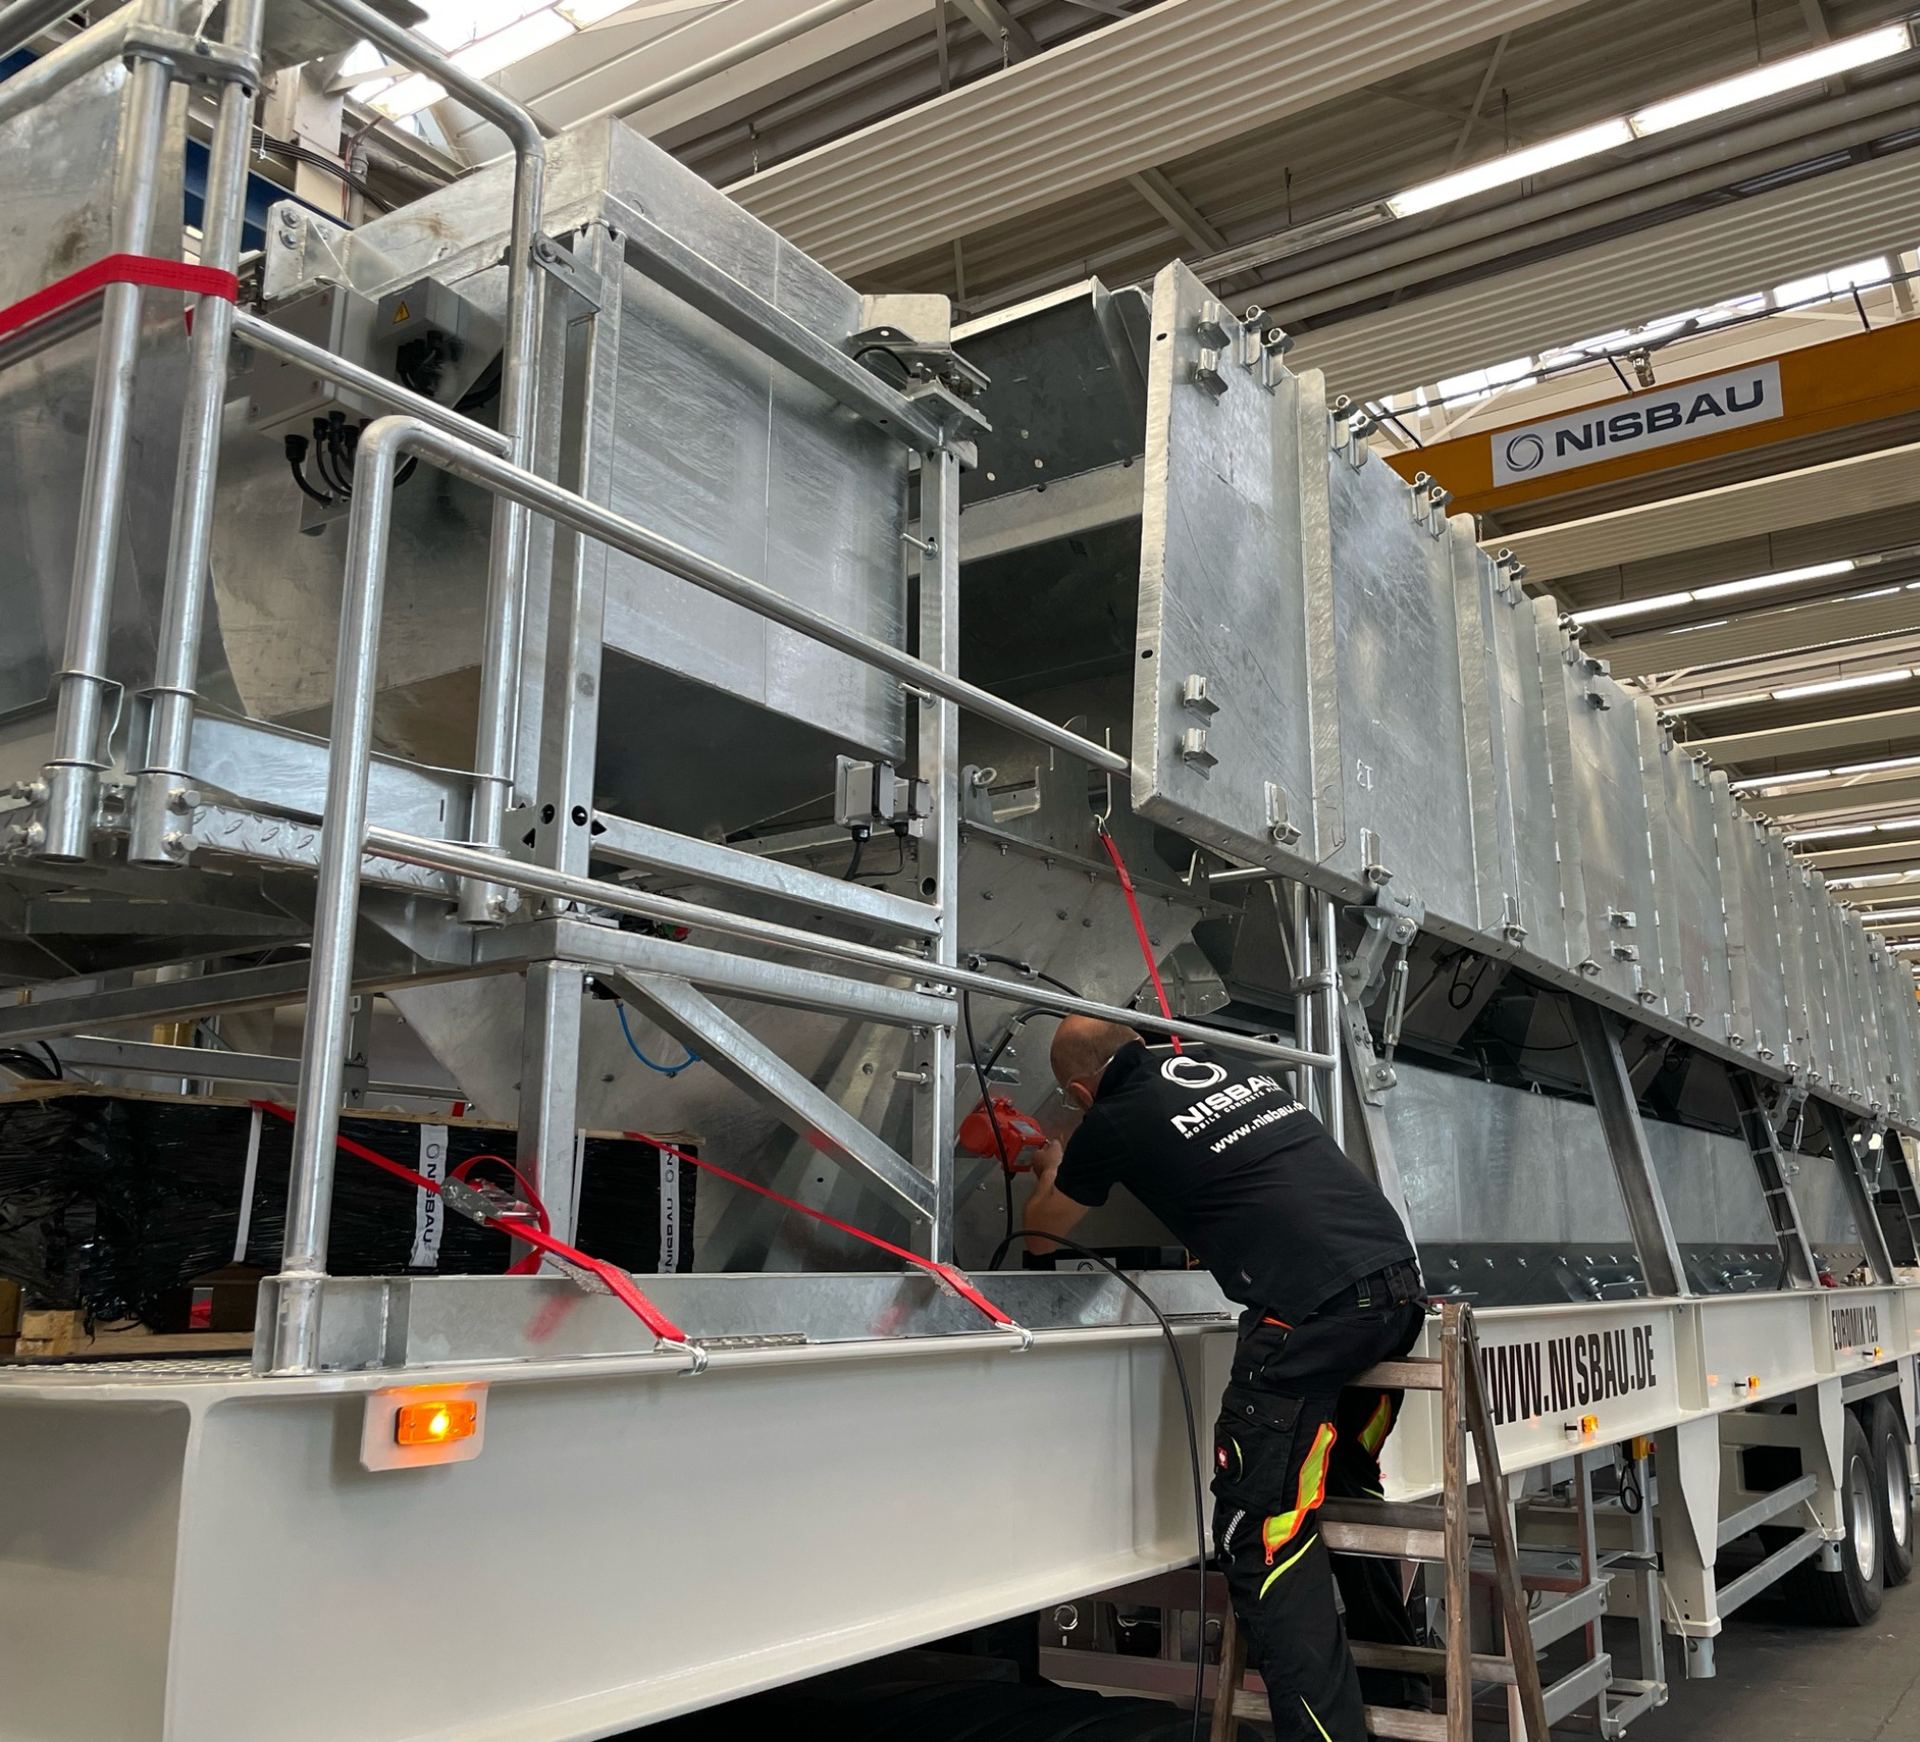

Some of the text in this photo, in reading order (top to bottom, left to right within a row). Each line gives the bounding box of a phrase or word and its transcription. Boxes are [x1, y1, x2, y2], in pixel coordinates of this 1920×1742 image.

[1555, 379, 1764, 457] NISBAU
[1171, 1074, 1279, 1134] NISBAU
[1184, 1113, 1221, 1139] MOBILE
[1224, 1090, 1265, 1113] CONCRETE
